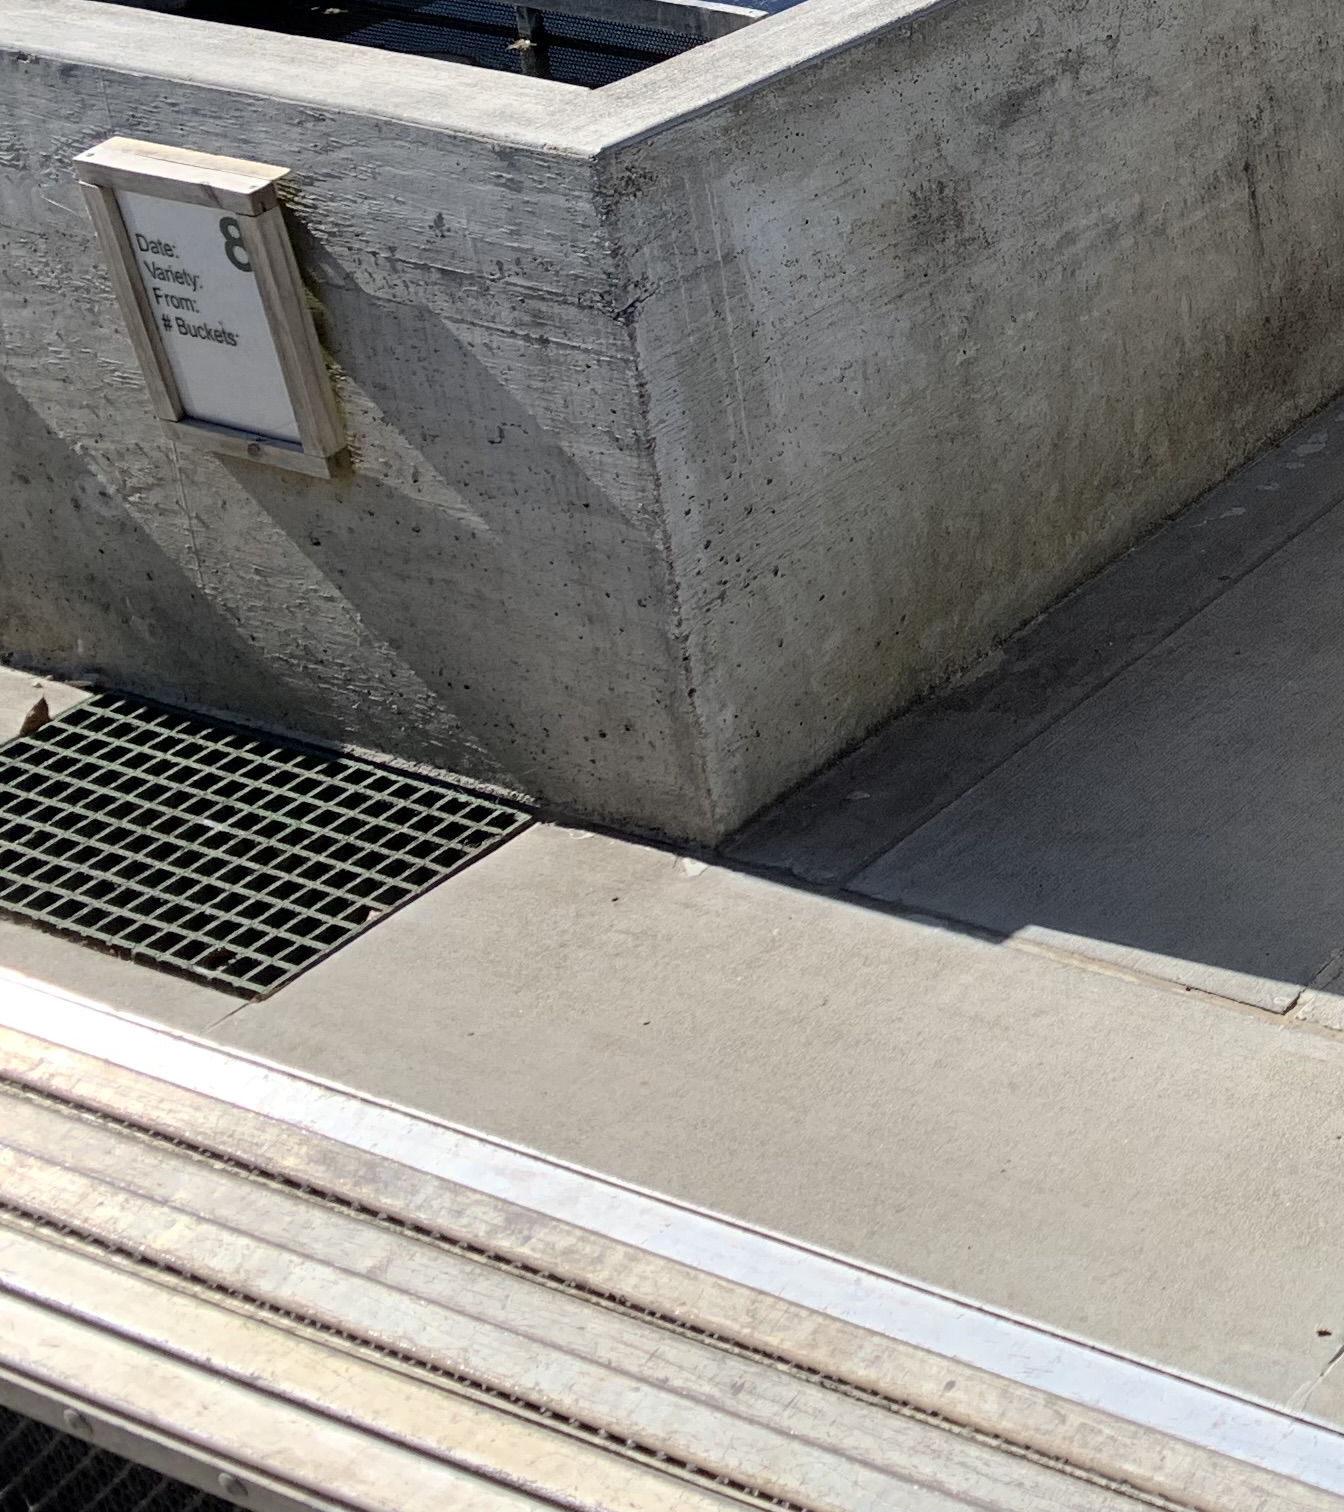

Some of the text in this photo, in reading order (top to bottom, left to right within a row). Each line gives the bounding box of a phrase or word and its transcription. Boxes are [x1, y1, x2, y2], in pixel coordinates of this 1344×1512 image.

[135, 233, 180, 259] Date:
[218, 216, 253, 273] 8
[143, 260, 203, 292] Variety:
[152, 287, 200, 314] From:
[162, 313, 240, 347] # Buckets:
